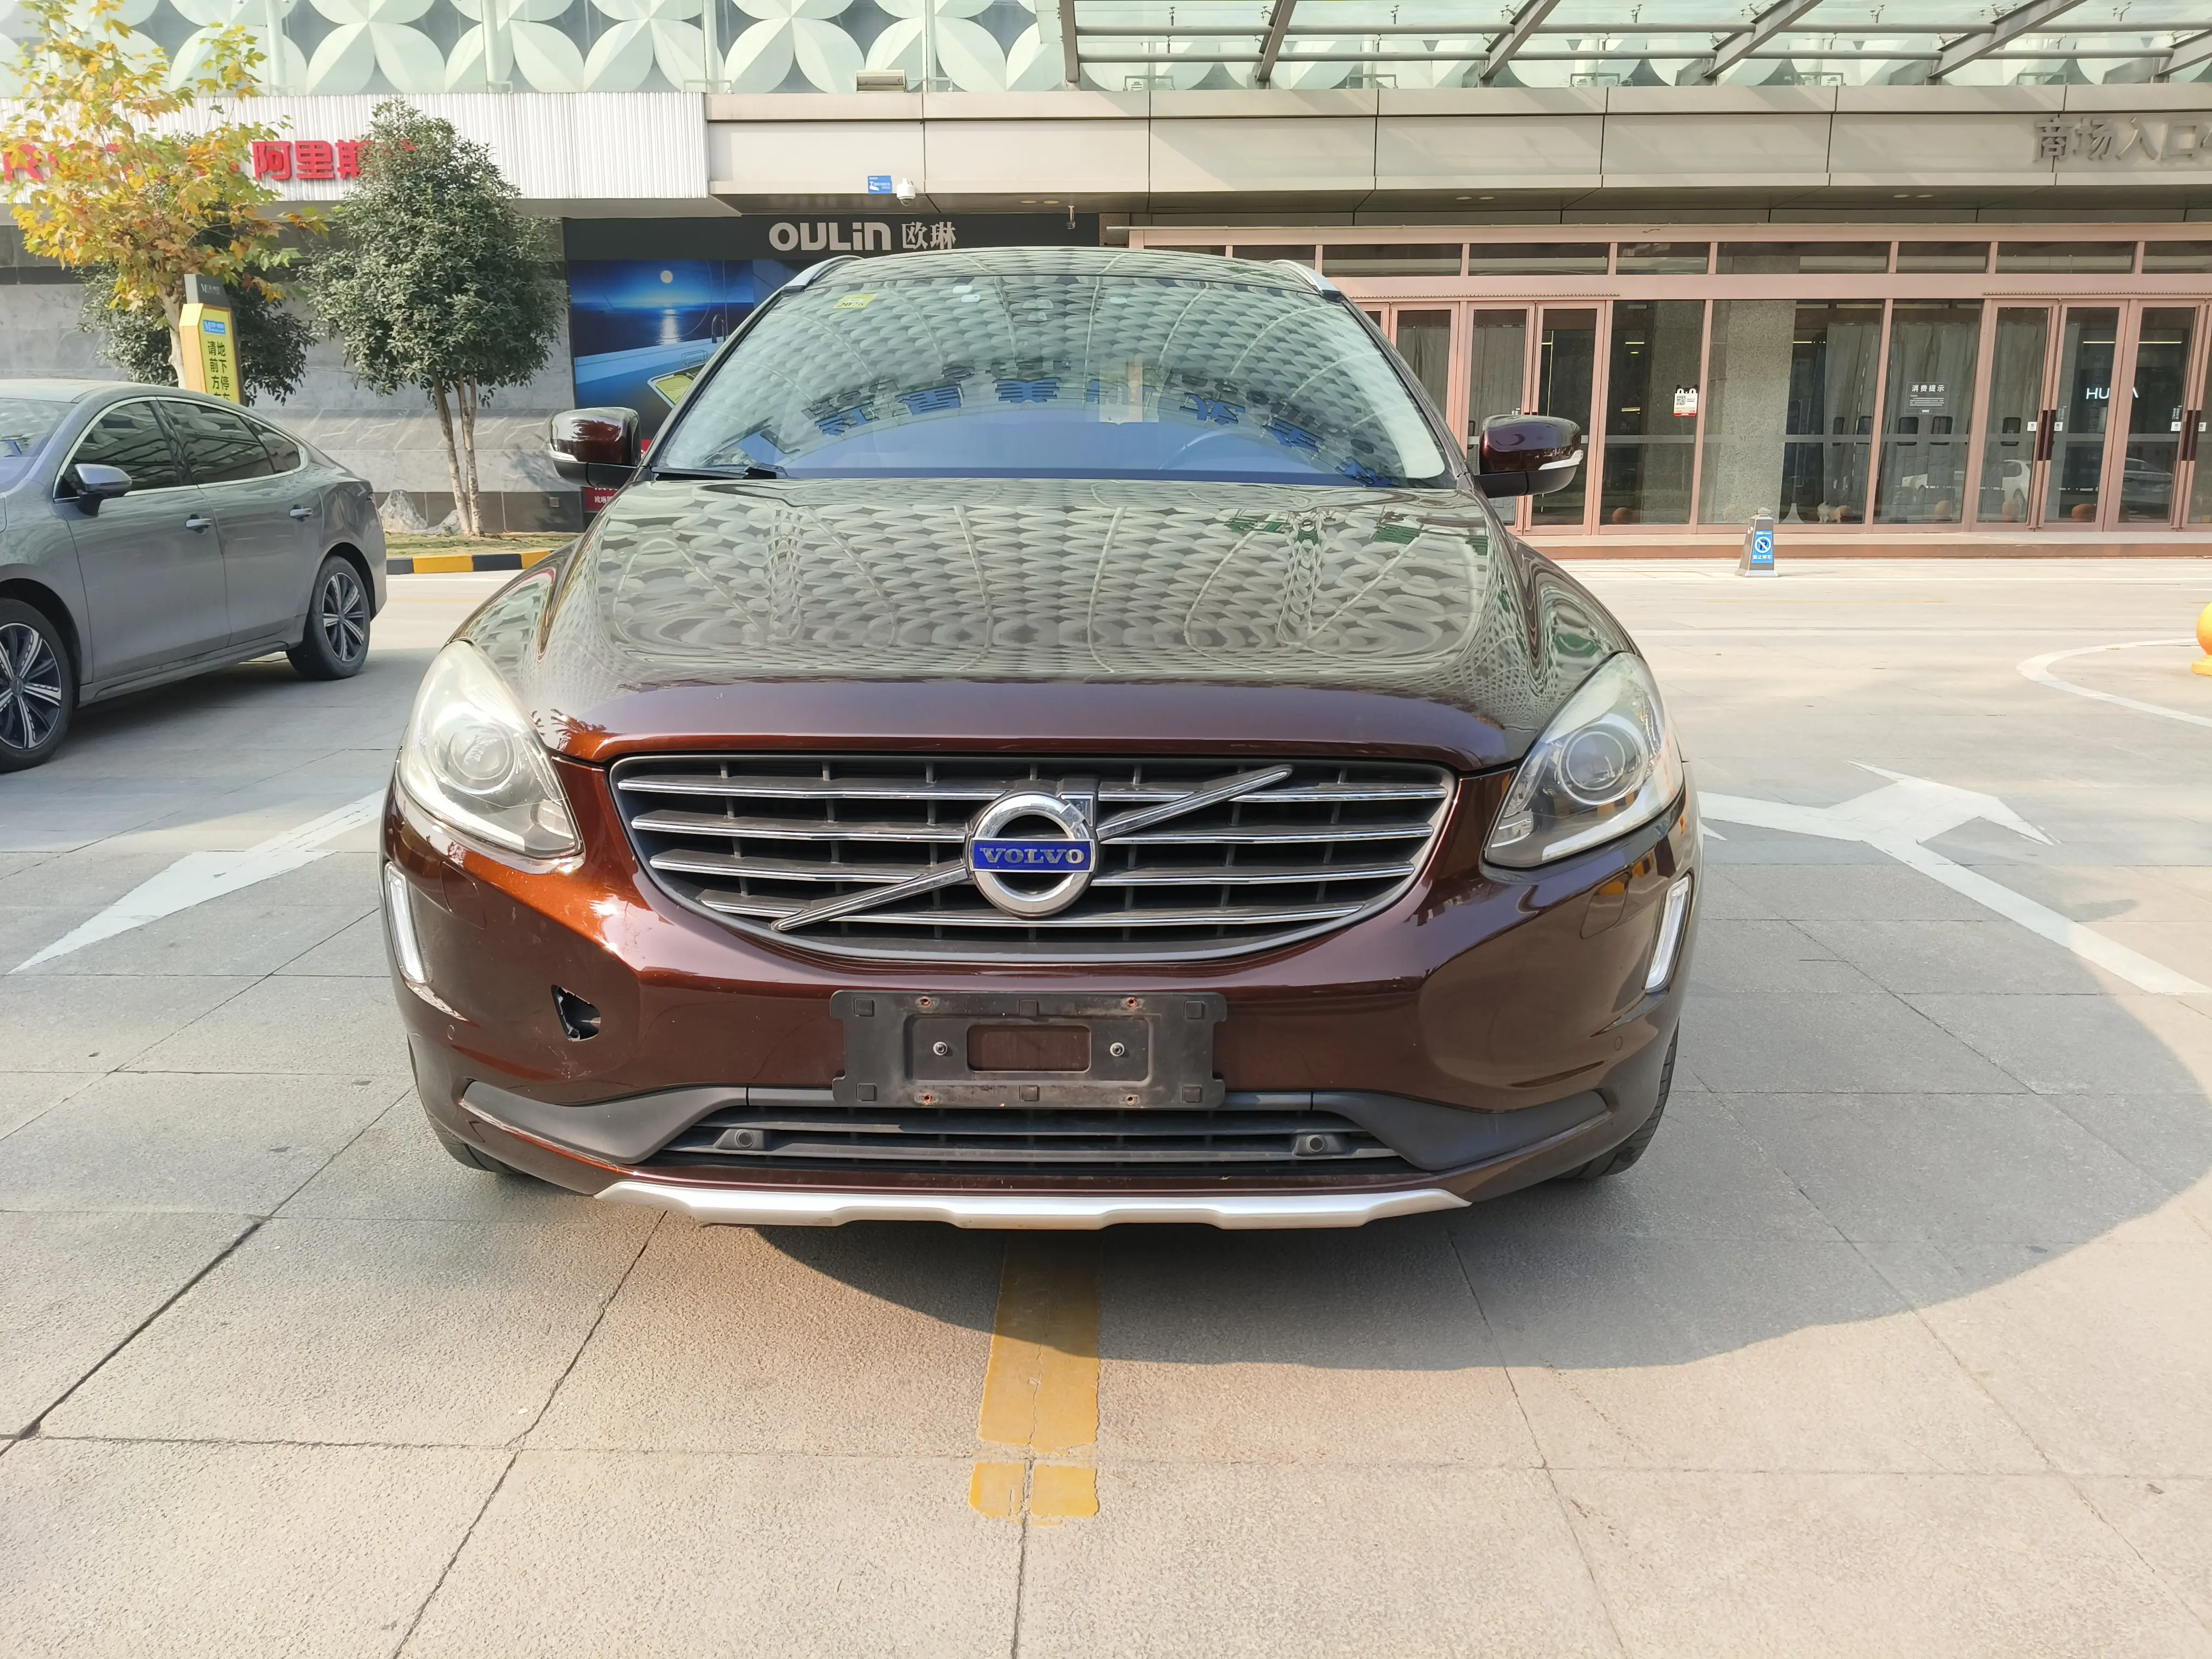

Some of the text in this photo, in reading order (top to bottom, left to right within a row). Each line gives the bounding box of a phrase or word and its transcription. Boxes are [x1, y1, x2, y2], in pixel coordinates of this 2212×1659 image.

[2033, 117, 2212, 161] 商场入口
[252, 139, 415, 181] 阿里斯
[901, 221, 956, 249] 欧琳
[980, 848, 1084, 863] VOLVO
